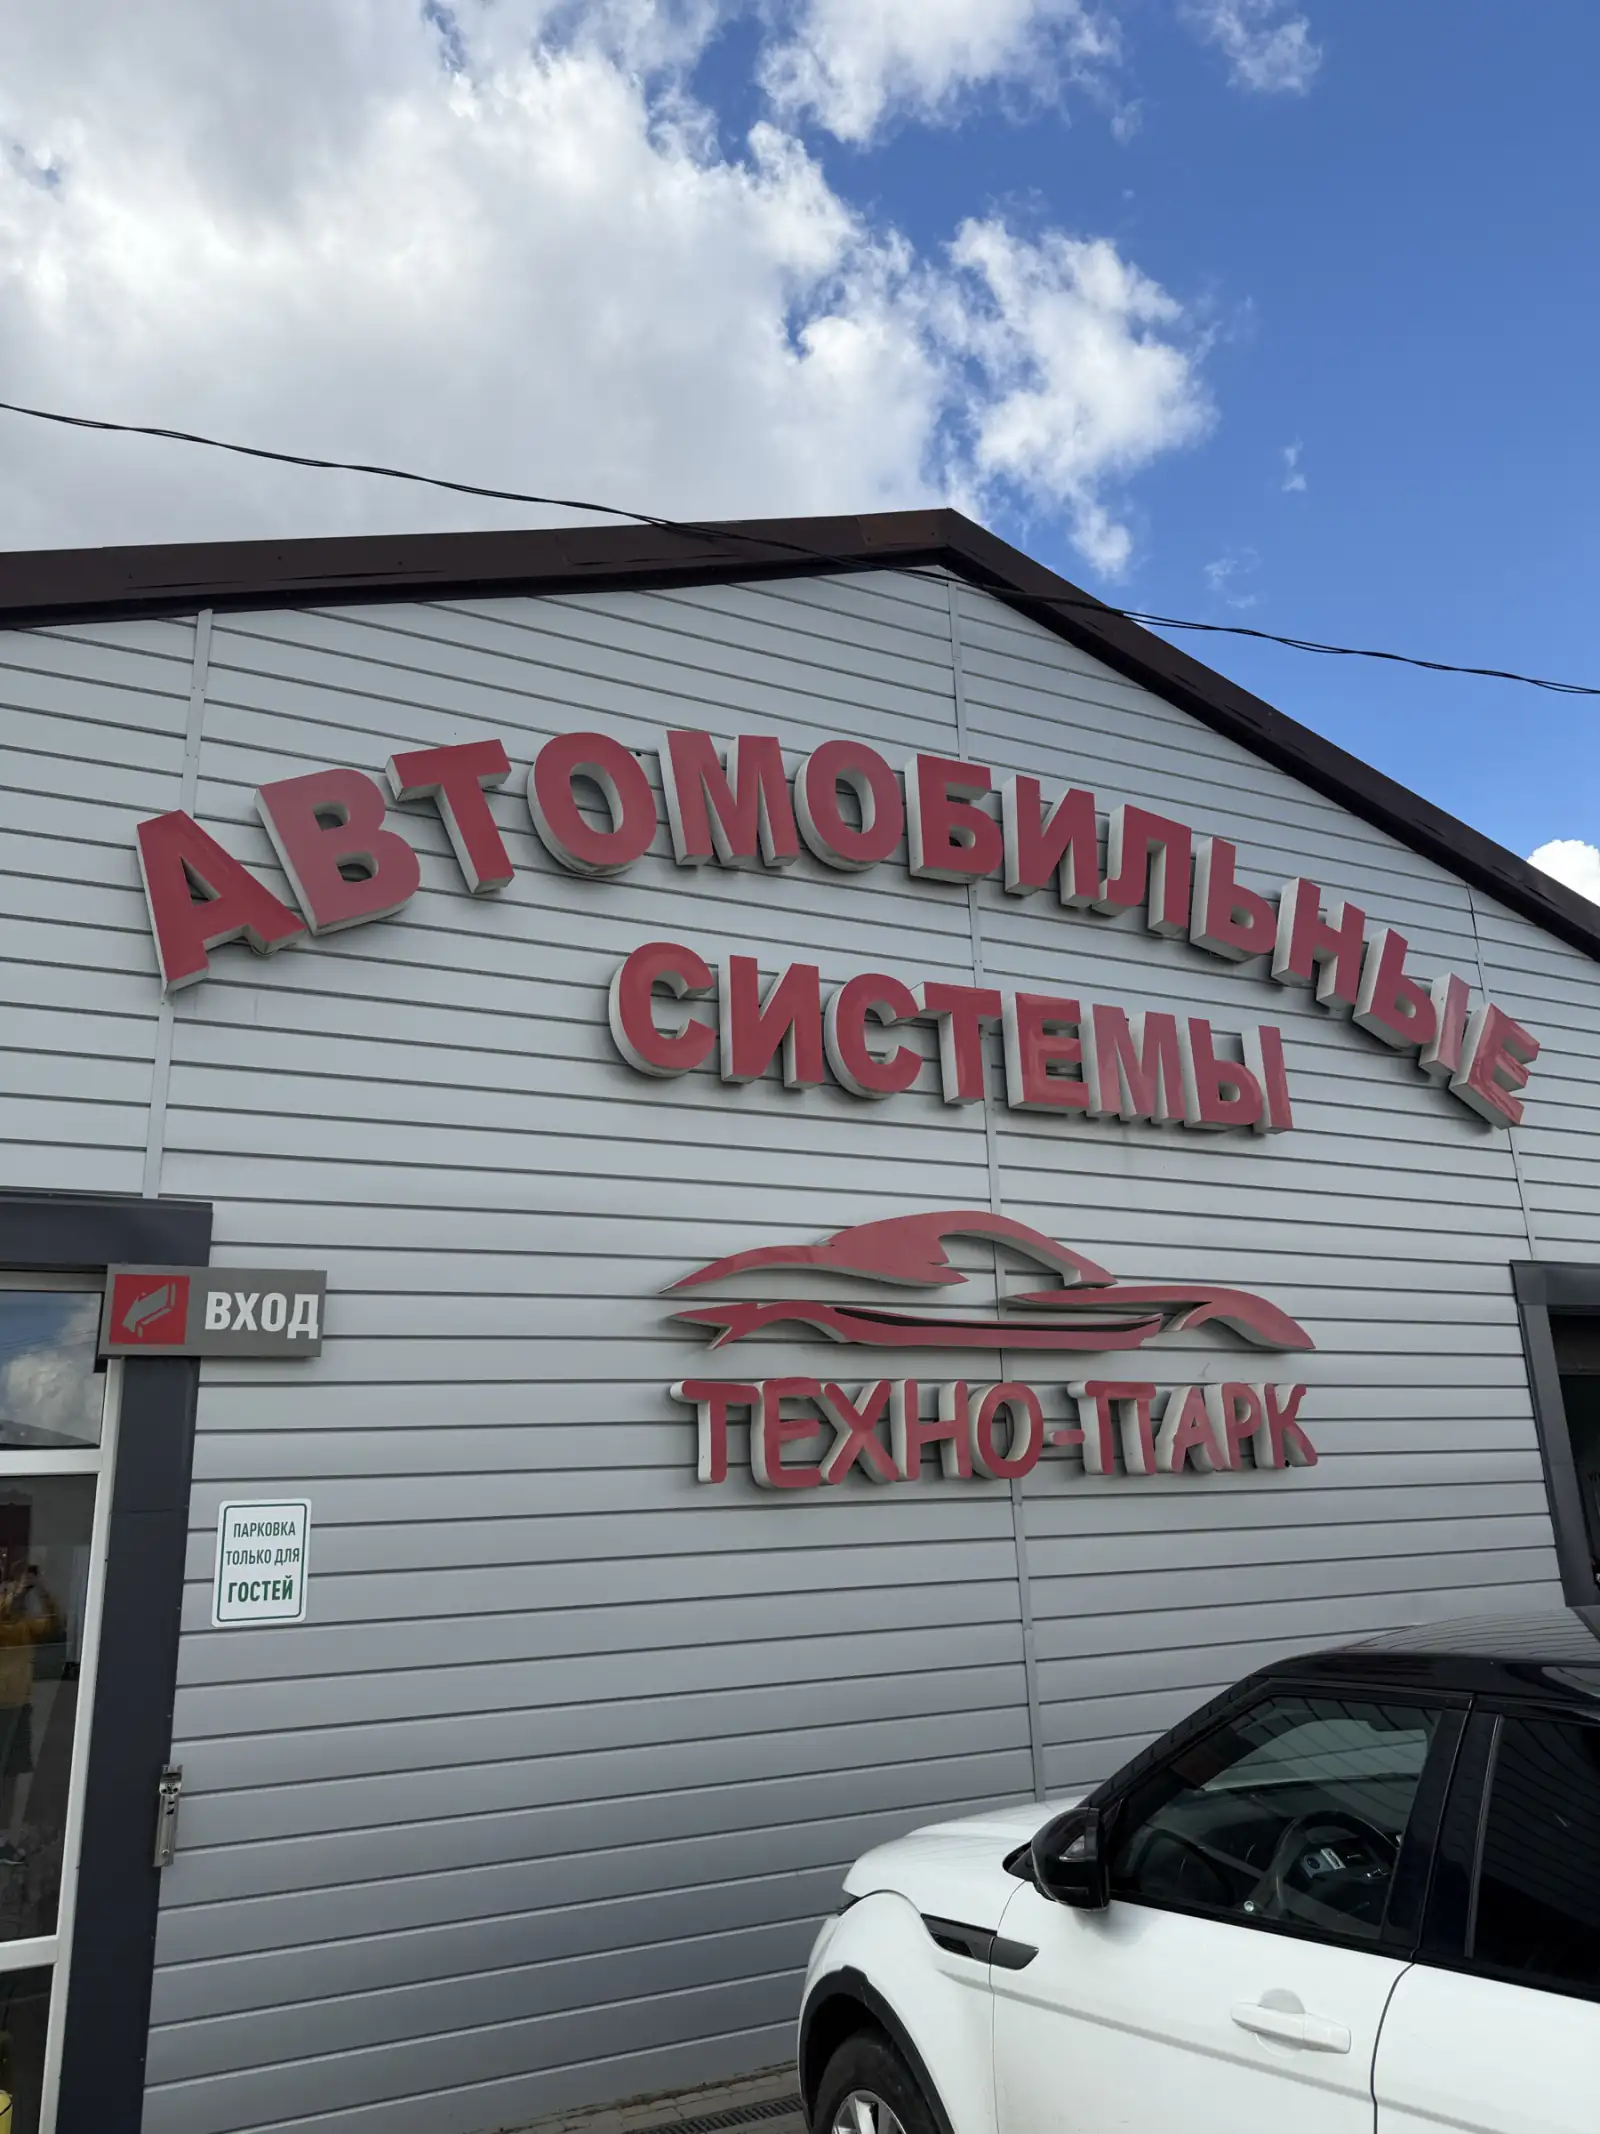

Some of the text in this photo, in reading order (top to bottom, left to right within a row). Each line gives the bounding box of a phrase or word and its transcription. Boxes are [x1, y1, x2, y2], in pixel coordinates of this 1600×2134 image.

[137, 729, 1540, 1129] АВТОМОБИЛЬНЫЕ
[609, 941, 1293, 1134] СИСТЕМЫ
[204, 1291, 319, 1339] ВХОД
[669, 1378, 1319, 1488] ТЕХНО-ПАРК
[232, 1521, 297, 1538] ПАРКОВКА
[225, 1547, 301, 1567] ТОЛЬКО ДЛЯ
[227, 1575, 294, 1604] ГОСТЕЙ
